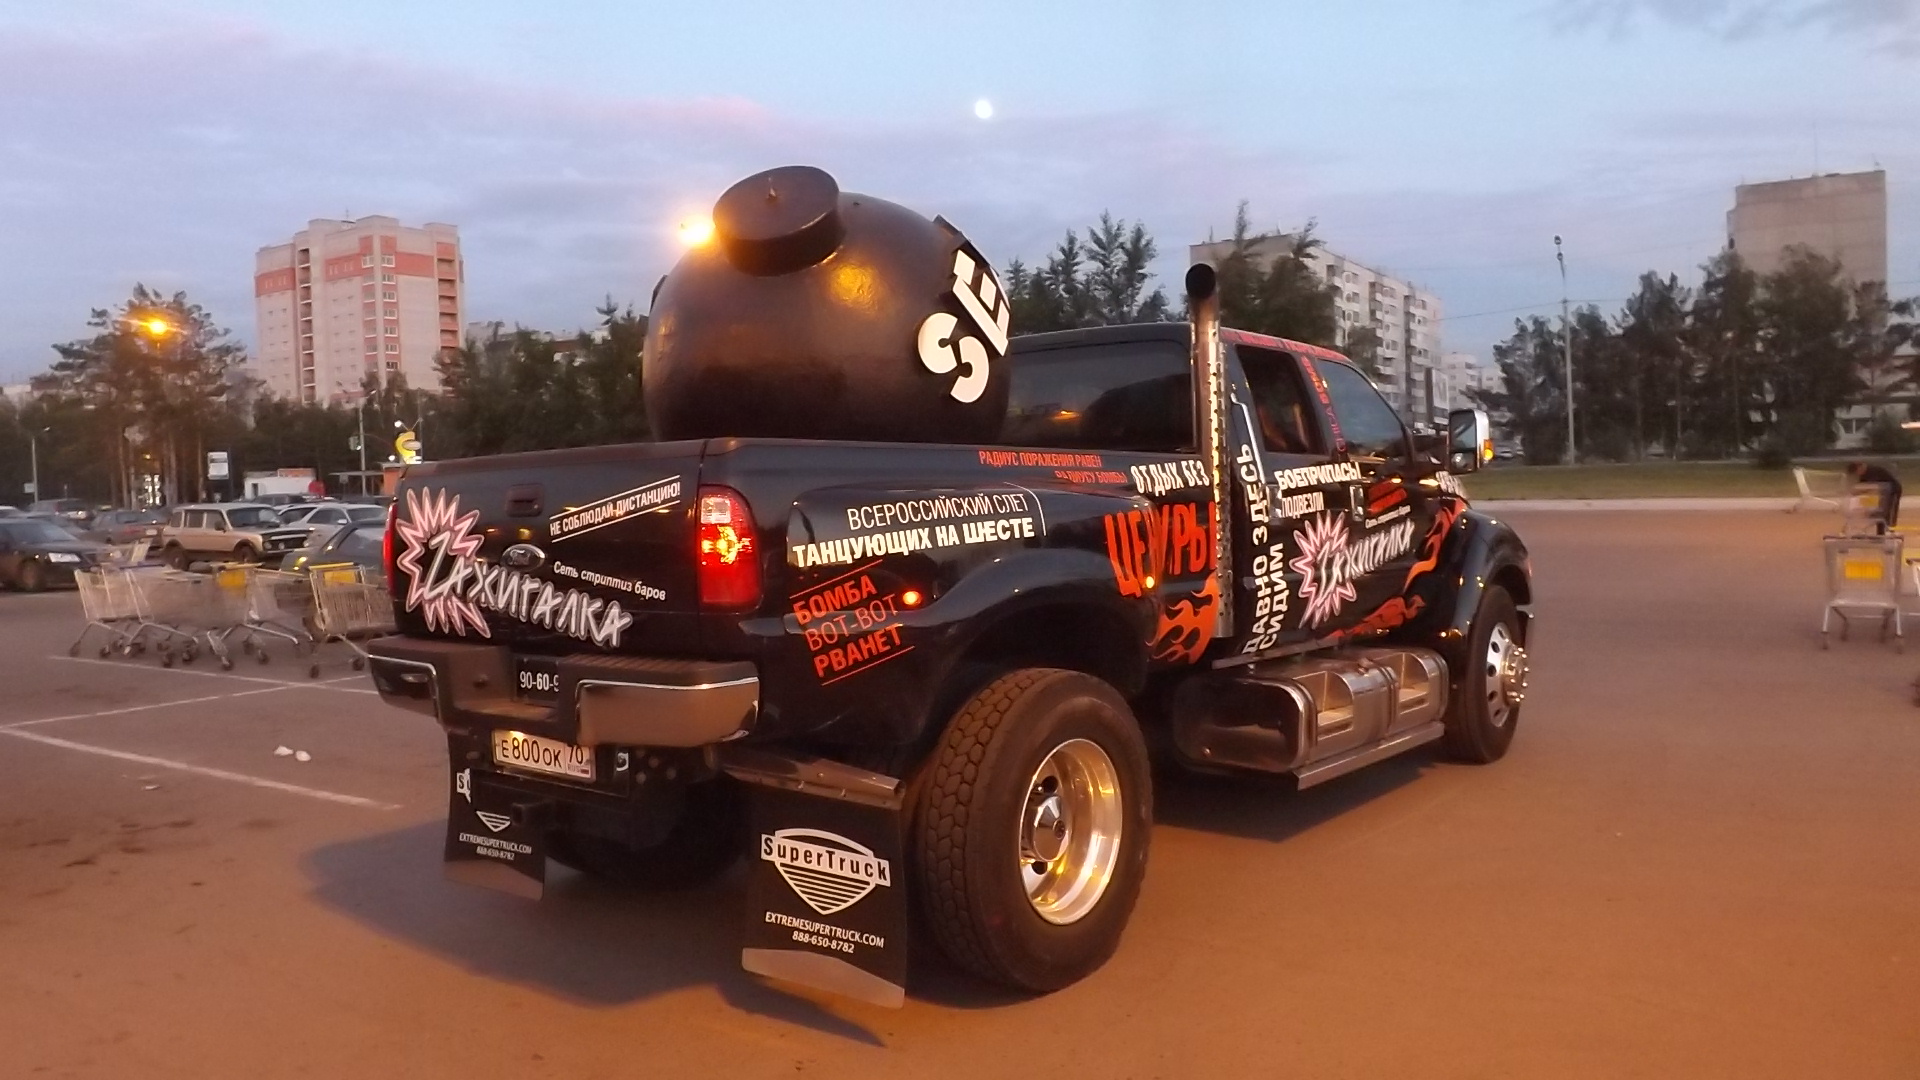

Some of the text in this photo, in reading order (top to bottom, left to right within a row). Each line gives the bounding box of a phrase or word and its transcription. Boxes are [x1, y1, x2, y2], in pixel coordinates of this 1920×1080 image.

[979, 451, 1102, 468] РАДИУС ПОРАЖЕНИЯ РАВЕН
[1096, 471, 1128, 484] БОМБЫ
[1131, 460, 1210, 497] ОТДЫХ БЕЗ
[1274, 461, 1362, 491] БОЕПРИПАСЫ
[550, 481, 680, 536] НЕ СОБЛЮДАЙ ДИСТАНЦИЮ!
[847, 492, 1029, 531] ВСЕРОССИЙСКИЙ СЛЕТ
[1281, 491, 1324, 520] ПОДВЕЗЛИ
[793, 517, 1035, 568] ТАНЦУЮЩИХ НА ШЕСТЕ
[1237, 443, 1271, 655] ДАВНО ЗДЕСЬ
[553, 561, 666, 601] Сеть стриптиз баров
[792, 574, 878, 626] БОМБА
[1259, 543, 1289, 650] СИДИМ
[803, 594, 900, 652] ВОТ-ВОТ
[813, 622, 904, 678] РВАНЕТ
[763, 836, 888, 882] SuperTruck
[765, 911, 885, 949] EXTREMESUPERTRUCK.COM
[792, 930, 855, 954] 888-650-8782
